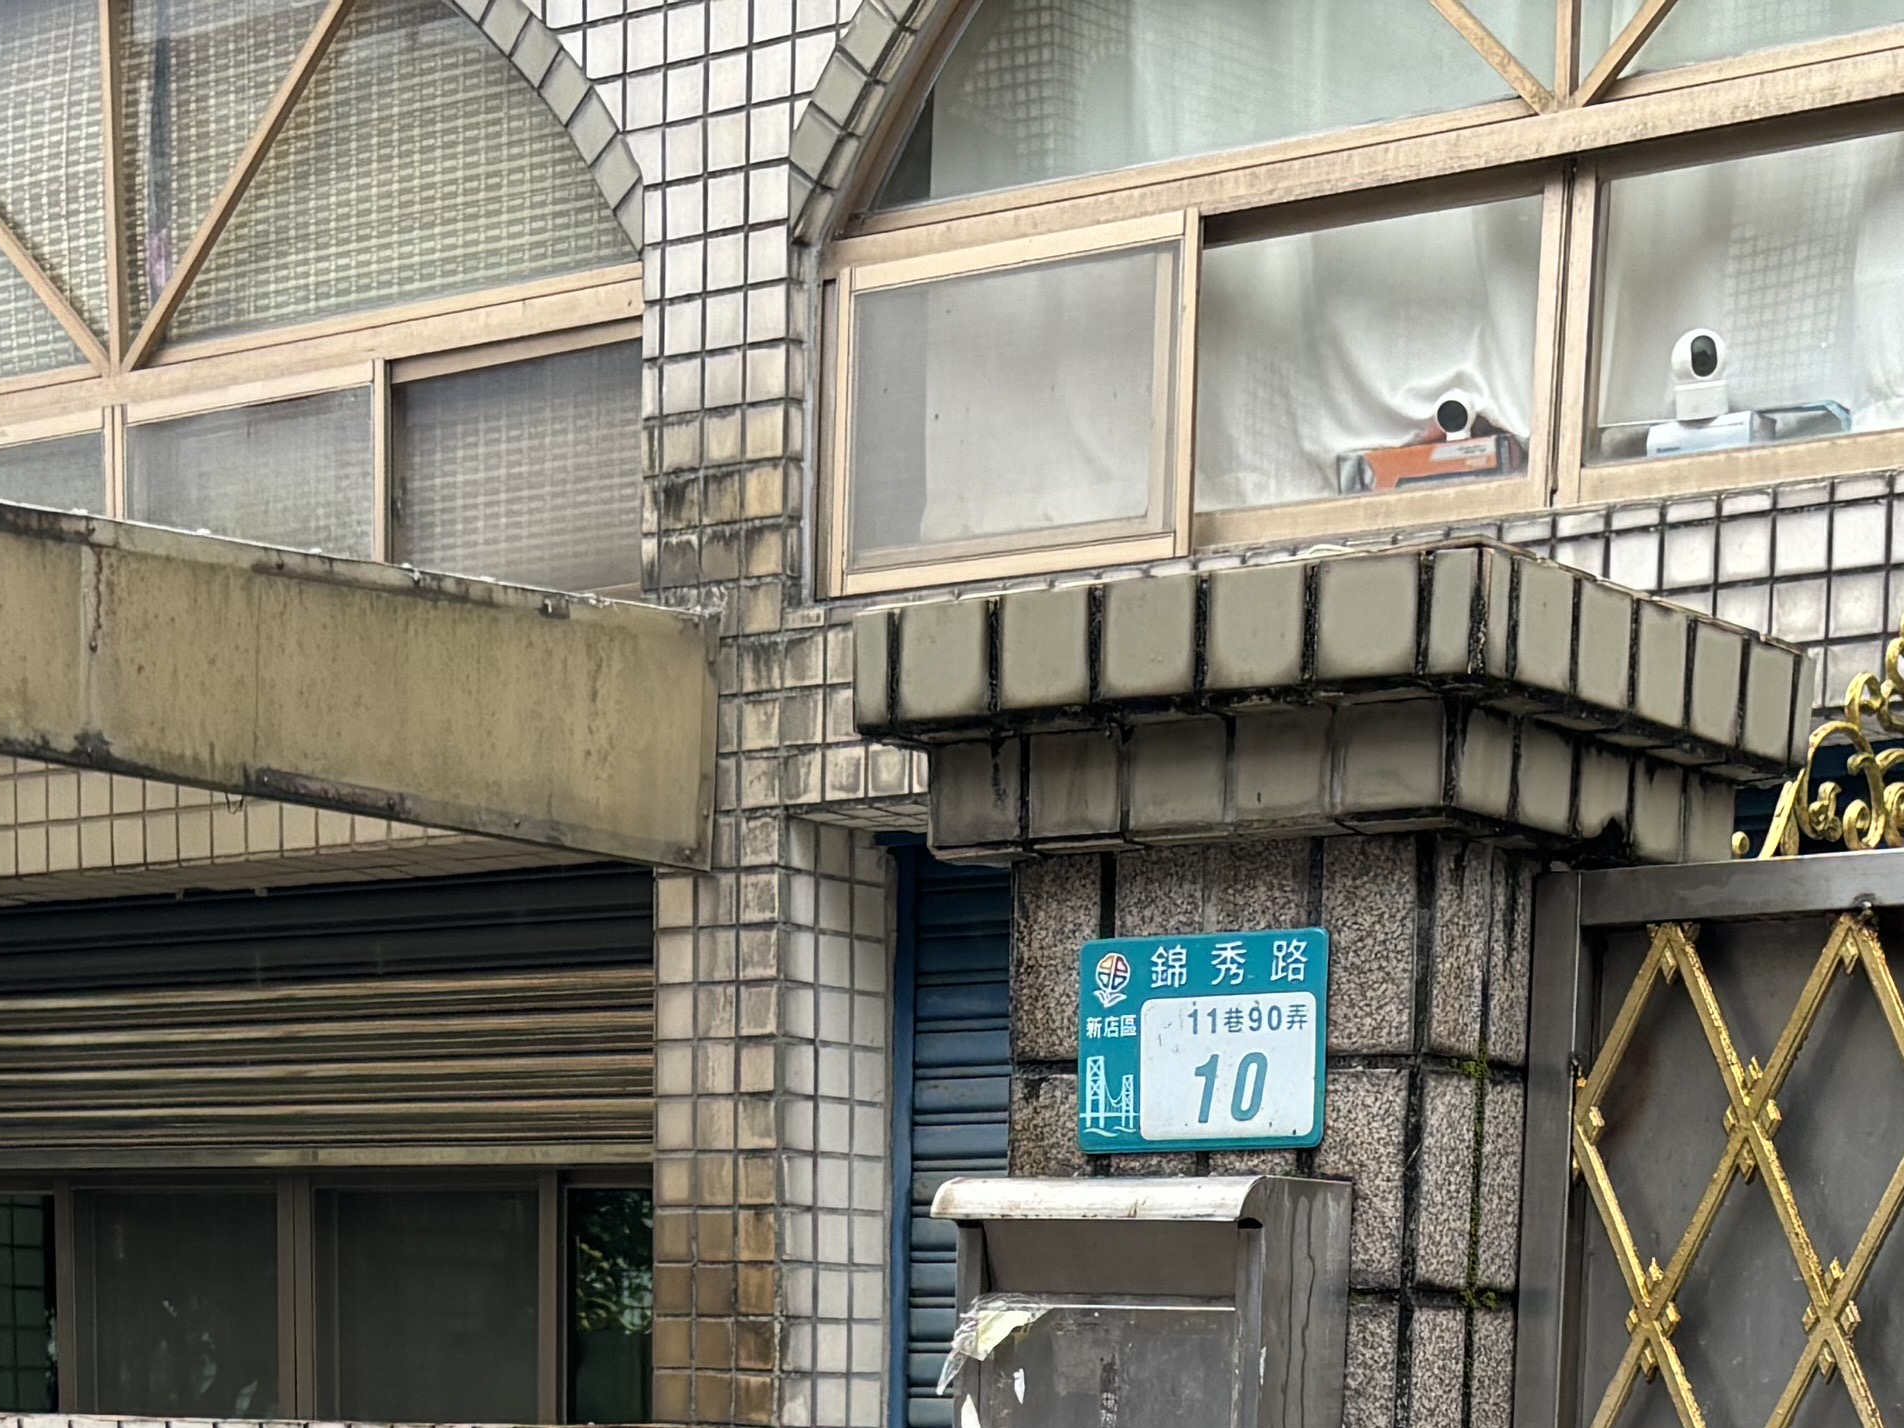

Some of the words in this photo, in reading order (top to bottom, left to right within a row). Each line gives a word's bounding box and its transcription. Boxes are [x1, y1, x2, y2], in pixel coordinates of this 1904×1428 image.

[1150, 938, 1309, 988] 錦秀路
[1085, 1014, 1138, 1039] 新店區
[1187, 1003, 1309, 1036] 11巷90弄
[1193, 1051, 1269, 1124] 10
